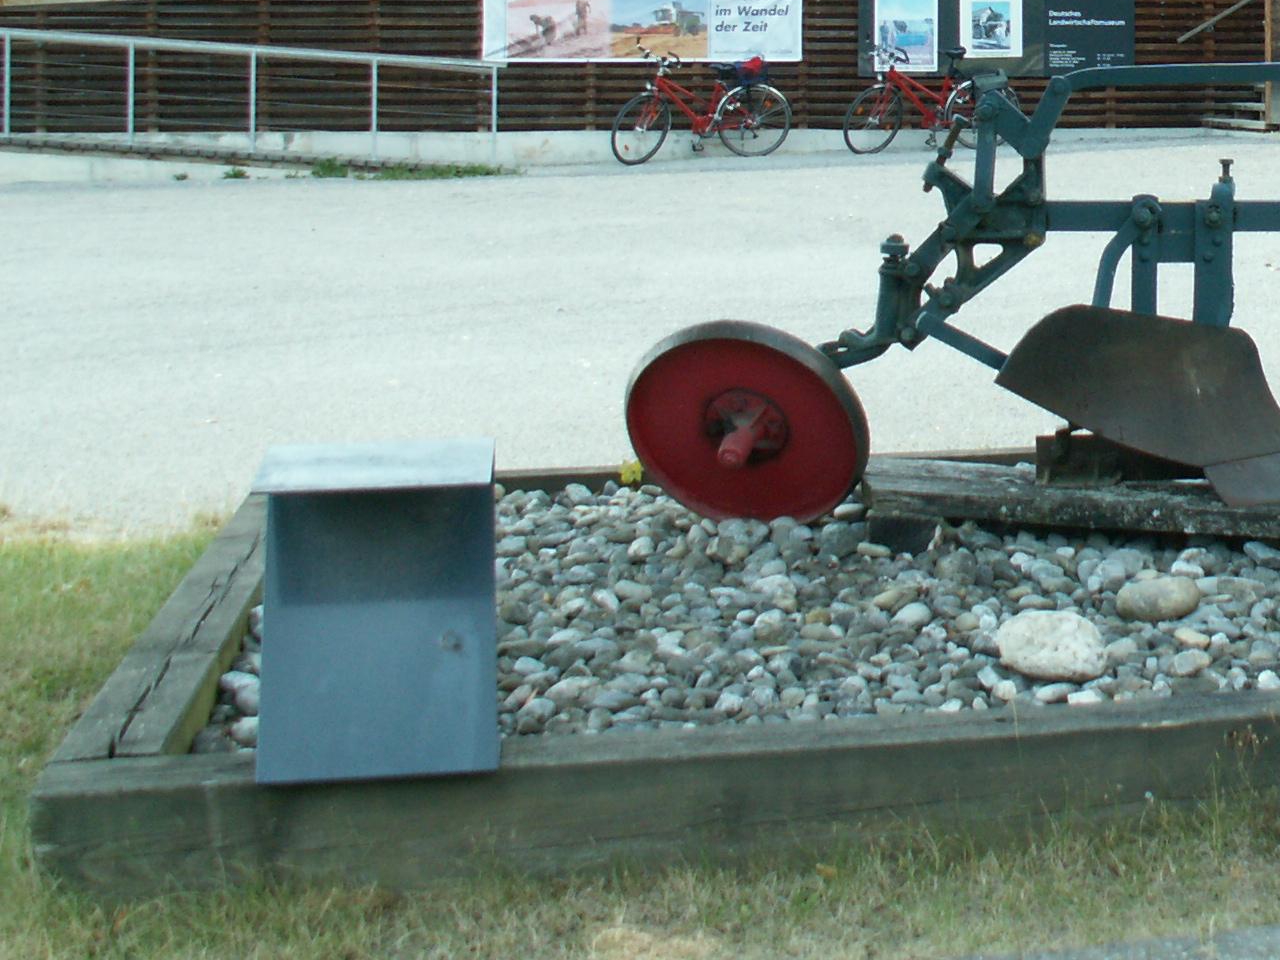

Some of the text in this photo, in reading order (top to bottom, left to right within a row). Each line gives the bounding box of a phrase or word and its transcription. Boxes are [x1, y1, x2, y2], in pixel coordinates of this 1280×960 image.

[715, 4, 789, 16] im Wandel
[715, 20, 769, 32] der Zeit
